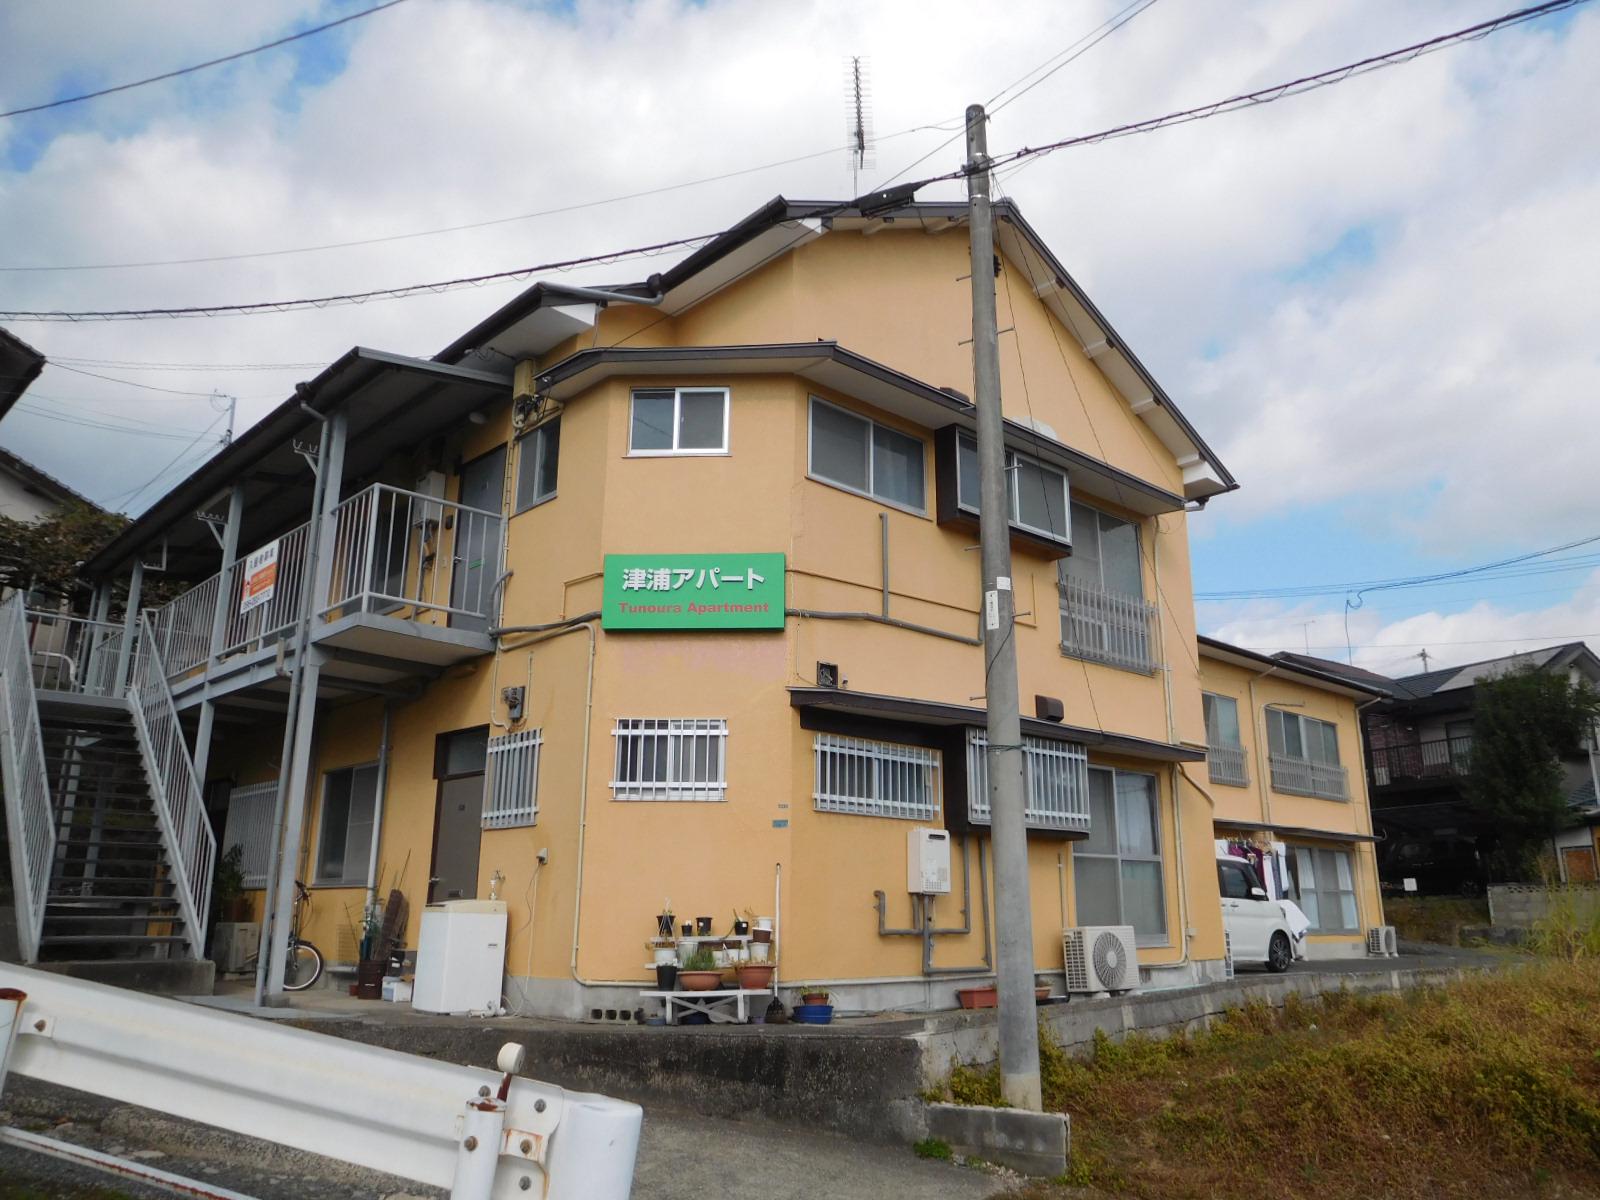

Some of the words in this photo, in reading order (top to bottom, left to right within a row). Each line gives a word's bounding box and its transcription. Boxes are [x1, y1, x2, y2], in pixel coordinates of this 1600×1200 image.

[622, 567, 765, 592] 津浦アパート
[620, 602, 682, 614] Tunoura
[687, 602, 769, 615] Apartment
